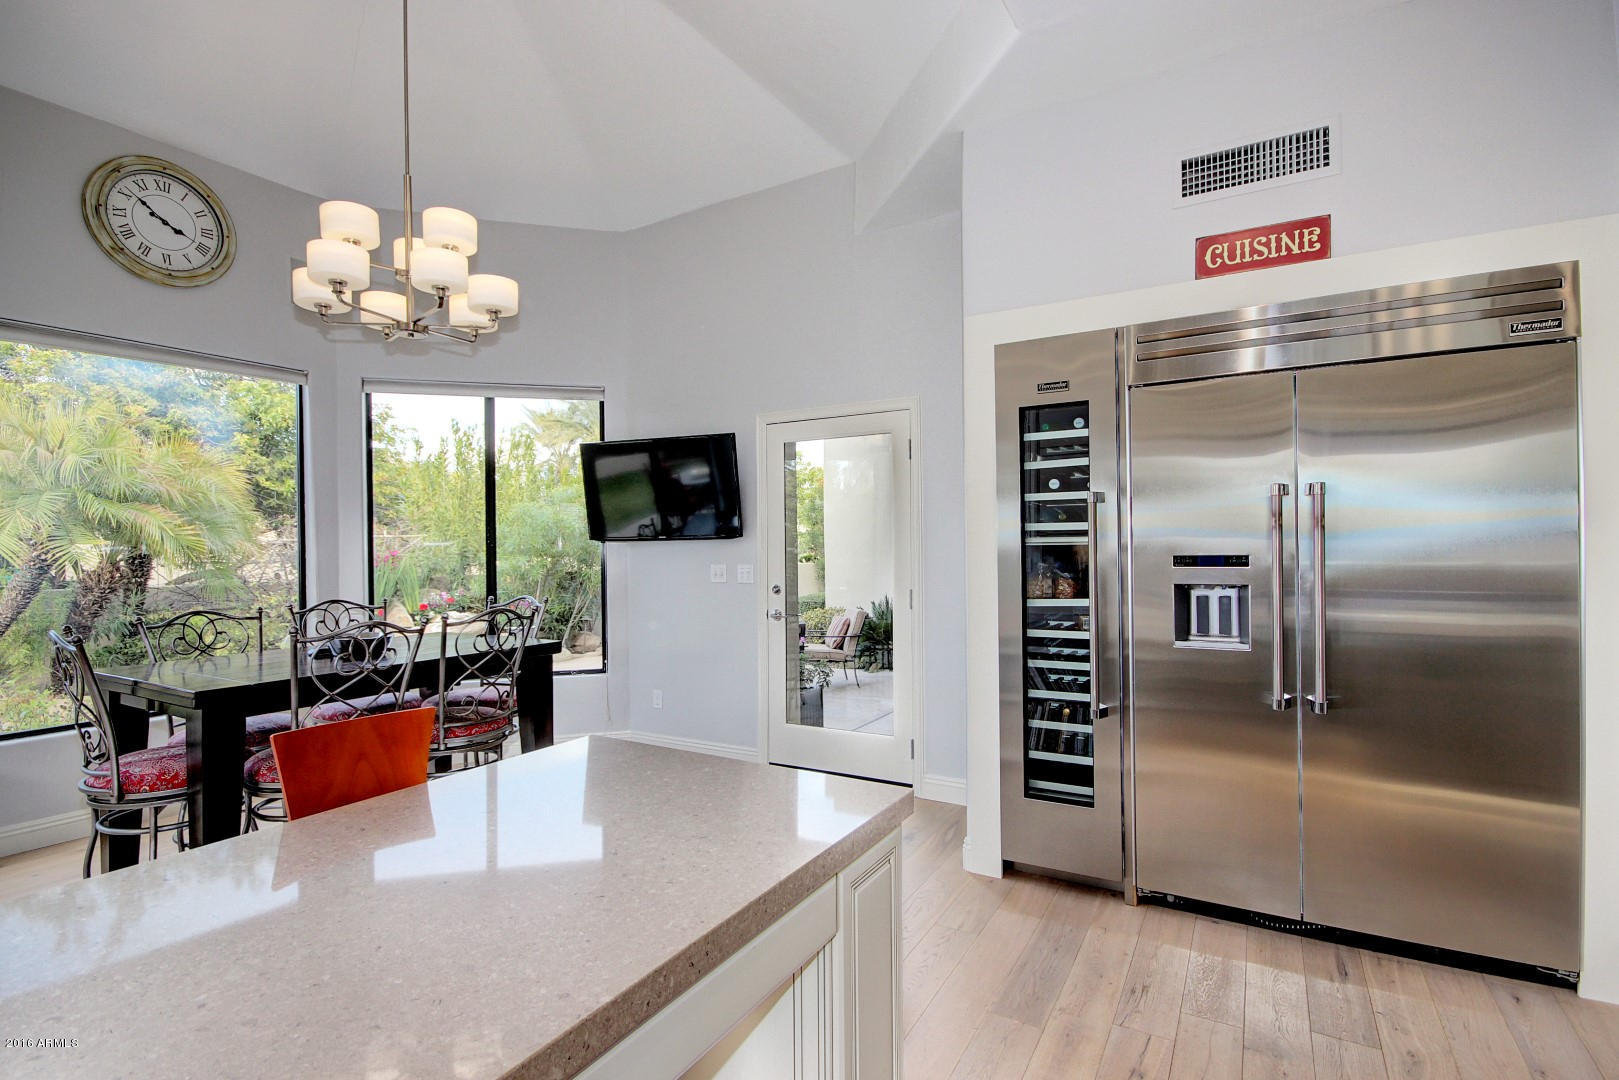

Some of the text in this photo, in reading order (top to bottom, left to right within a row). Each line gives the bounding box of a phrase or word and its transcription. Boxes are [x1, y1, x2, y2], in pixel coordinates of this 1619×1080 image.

[132, 178, 149, 193] XI
[153, 178, 172, 194] XII
[194, 209, 207, 218] II
[118, 223, 136, 240] VIII
[200, 228, 214, 241] III
[136, 242, 152, 257] VII
[1205, 227, 1321, 269] CUISINE
[161, 253, 172, 266] VI
[182, 253, 192, 264] V
[1511, 319, 1560, 331] Thermador
